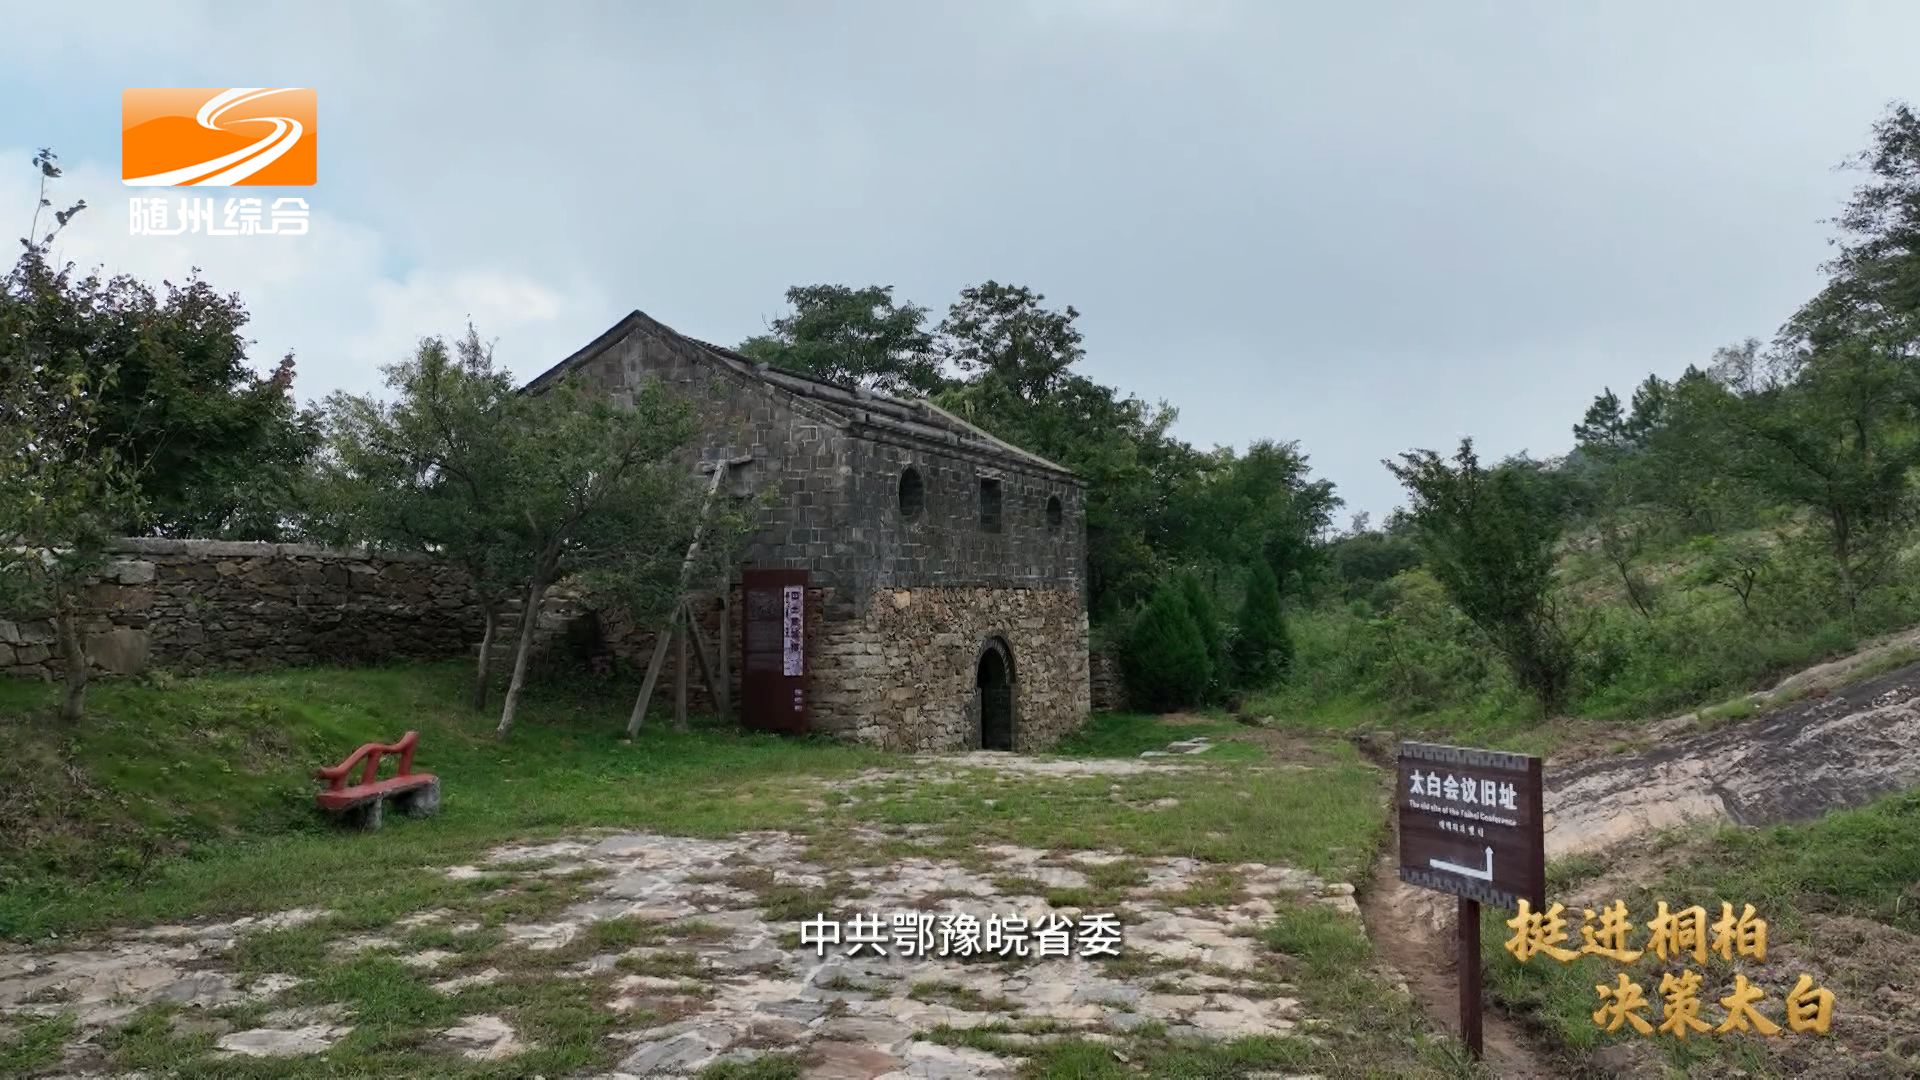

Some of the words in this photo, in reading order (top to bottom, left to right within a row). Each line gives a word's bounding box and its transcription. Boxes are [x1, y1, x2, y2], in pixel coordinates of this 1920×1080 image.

[1409, 769, 1518, 810] 太白会议旧址
[1409, 799, 1420, 809] The
[1442, 805, 1449, 814] of
[1449, 807, 1460, 816] the
